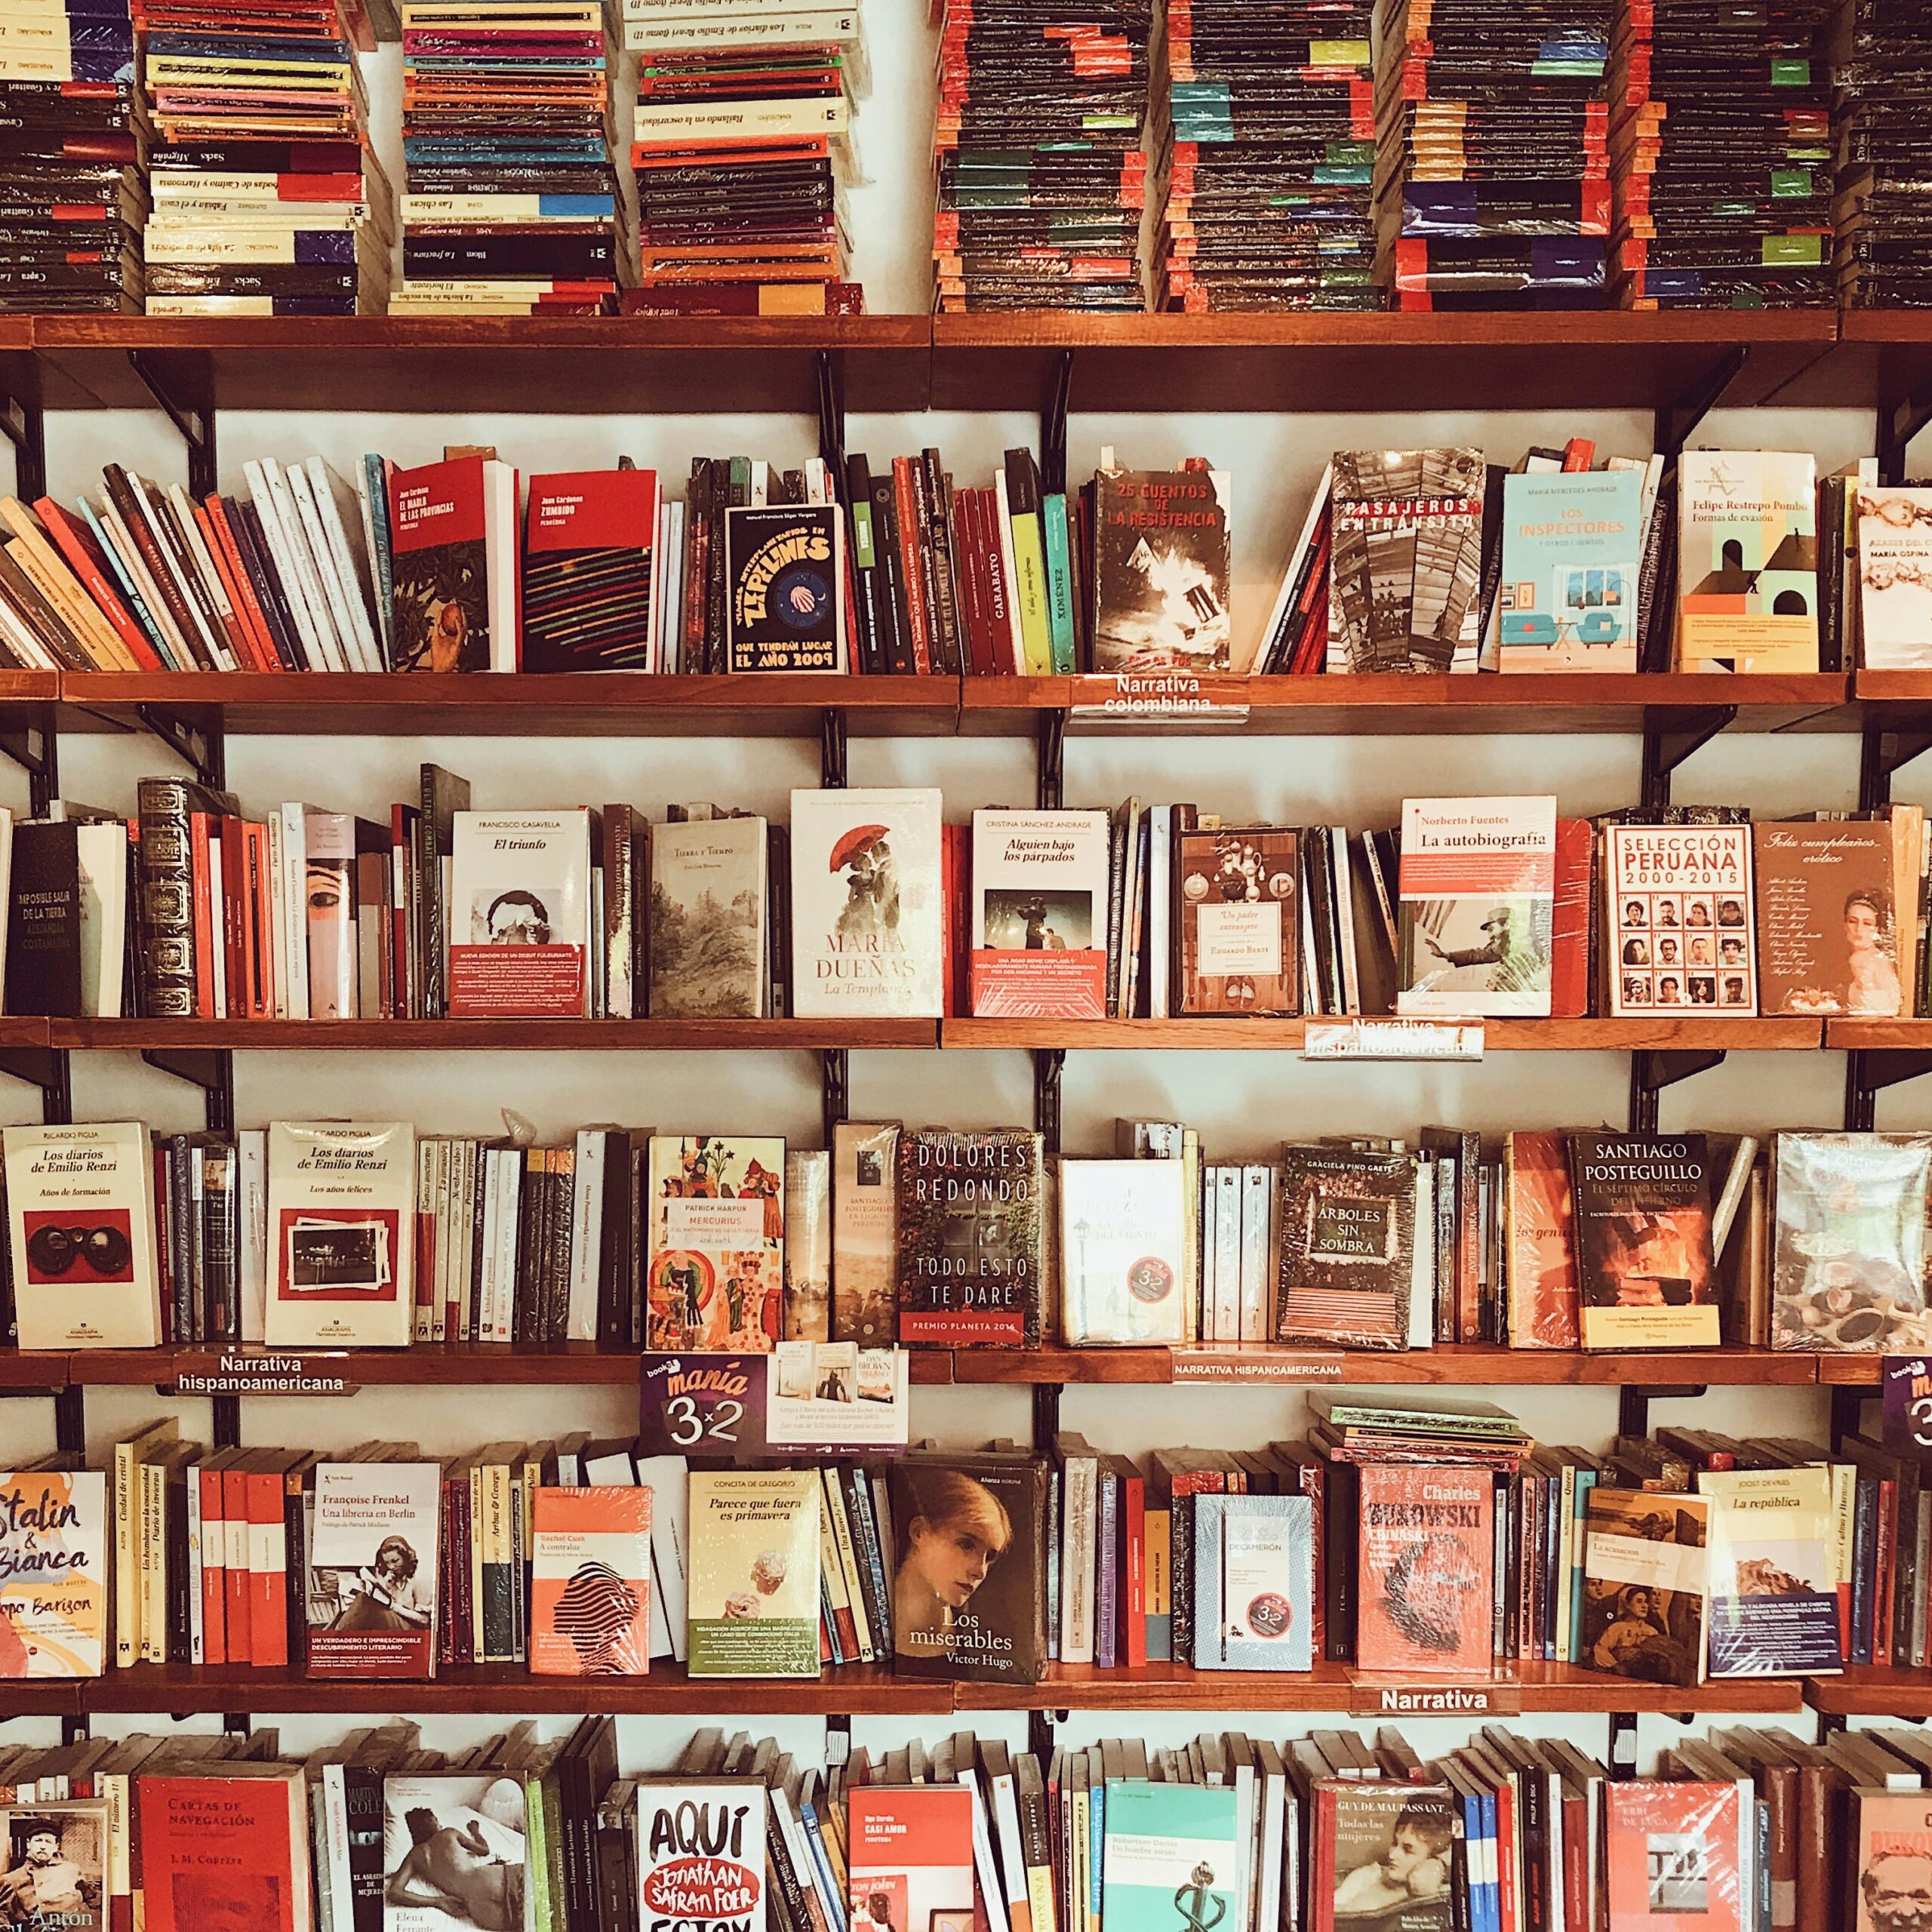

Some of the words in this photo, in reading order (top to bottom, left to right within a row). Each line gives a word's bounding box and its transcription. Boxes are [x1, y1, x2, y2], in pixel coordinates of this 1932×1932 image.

[644, 117, 685, 126] oscuridad
[687, 116, 693, 125] la
[708, 114, 744, 124] Bailando
[201, 153, 225, 162] Sacks
[399, 501, 406, 510] EL
[541, 505, 575, 516] ZUMBIDO
[1346, 499, 1469, 516] PASAJEROS
[1692, 500, 1722, 512] Felipe
[1727, 500, 1770, 513] Restrepo
[1774, 500, 1807, 511] Pombo
[400, 512, 408, 521] DE
[409, 510, 419, 519] LAS
[420, 503, 454, 518] PROVINCIAS
[1561, 509, 1582, 518] LOS
[1693, 513, 1725, 522] Formas
[1728, 513, 1739, 522] de
[1741, 512, 1774, 522] evasión
[1340, 516, 1364, 531] EN
[1371, 513, 1473, 531] TRÁNSITO
[1518, 521, 1625, 537] INSPECTORES
[744, 537, 830, 628] ZEPELINES
[990, 553, 1004, 619] GARABATO
[736, 644, 753, 652] QUE
[802, 641, 832, 651] LUGAR
[736, 655, 752, 667] EL
[758, 651, 788, 666] AÑO
[793, 653, 833, 666] 2009
[1117, 676, 1199, 692] Narrativa
[1105, 696, 1211, 711] colombiana
[1421, 816, 1468, 826] Norberto
[1470, 815, 1509, 824] Fuentes
[494, 839, 506, 850] El
[509, 838, 546, 850] triunfo
[1007, 839, 1049, 851] Alguien
[1052, 839, 1075, 851] bajo
[1422, 834, 1438, 848] La
[1444, 831, 1546, 850] autobiografía
[1624, 834, 1736, 851] SELECCIÓN
[1004, 851, 1020, 862] los
[1022, 851, 1075, 863] párpados
[1625, 853, 1737, 869] PERUANA
[1803, 851, 1843, 863] erótico
[1626, 872, 1737, 883] 2000-2015
[826, 933, 906, 952] MARÍA
[816, 955, 916, 977] DUEÑAS
[1352, 1019, 1435, 1034] Narrativa
[43, 1150, 62, 1161] Los
[66, 1149, 103, 1160] diarios
[311, 1147, 331, 1158] Los
[335, 1147, 373, 1158] diarios
[919, 1145, 1026, 1167] DOLORES
[1596, 1144, 1686, 1158] SANTIAGO
[31, 1162, 44, 1173] de
[48, 1161, 82, 1172] Emilio
[86, 1161, 117, 1171] Renzi
[297, 1159, 311, 1170] de
[315, 1158, 351, 1170] Emilio
[355, 1159, 387, 1170] Renzi
[1586, 1165, 1701, 1180] POSTEGUILLO
[39, 1188, 59, 1196] Años
[72, 1187, 110, 1197] formación
[309, 1185, 324, 1193] Los
[326, 1185, 344, 1193] años
[346, 1184, 372, 1194] felices
[916, 1179, 1029, 1201] REDONDO
[1318, 1203, 1380, 1223] ÁRBOLES
[690, 1217, 742, 1225] MERCURIUS
[1337, 1224, 1359, 1236] SIN
[1320, 1239, 1374, 1254] SOMBRA
[916, 1257, 966, 1276] TODO
[980, 1258, 1026, 1276] ESTO
[931, 1286, 951, 1304] TE
[964, 1283, 1013, 1304] DARÉ
[220, 1355, 302, 1372] Narrativa
[859, 1361, 891, 1370] BROWN
[1176, 1365, 1232, 1375] NARRATIVA
[1235, 1365, 1341, 1375] HISPANOAMERICANA
[179, 1374, 344, 1392] hispanoamericana
[667, 1361, 747, 1396] manía
[980, 1475, 1000, 1484] Alianza
[119, 1484, 127, 1494] de
[1423, 1485, 1481, 1500] Charles
[323, 1494, 370, 1506] Françoise
[373, 1495, 409, 1504] Frenkel
[709, 1498, 747, 1509] Parece
[749, 1500, 770, 1511] que
[773, 1497, 801, 1509] fuera
[1733, 1499, 1746, 1509] La
[1749, 1497, 1800, 1509] república
[323, 1509, 340, 1518] Una
[389, 1508, 416, 1518] Berlín
[720, 1512, 732, 1521] es
[735, 1511, 791, 1521] primavera
[24, 1533, 37, 1548] &
[1229, 1542, 1281, 1552] DECAMERÓN
[942, 1607, 980, 1629] Los
[909, 1629, 1013, 1651] miserables
[946, 1652, 980, 1666] Victor
[983, 1655, 1013, 1669] Hugo
[1381, 1691, 1487, 1709] Narrativa
[169, 1798, 219, 1811] CARTAS
[225, 1802, 240, 1810] DE
[1339, 1801, 1358, 1810] GUY
[1361, 1802, 1372, 1811] DE
[1374, 1803, 1444, 1814] MAUPASSANT
[169, 1814, 255, 1826] NAVEGACIÓN
[1338, 1819, 1367, 1829] Todas
[1369, 1820, 1384, 1829] las
[651, 1801, 749, 1863] AQUÍ
[865, 1825, 882, 1834] CASI
[884, 1825, 907, 1833] AMOR
[1112, 1837, 1151, 1846] Robertson
[1338, 1831, 1380, 1843] mujeres
[1124, 1846, 1152, 1854] hombre
